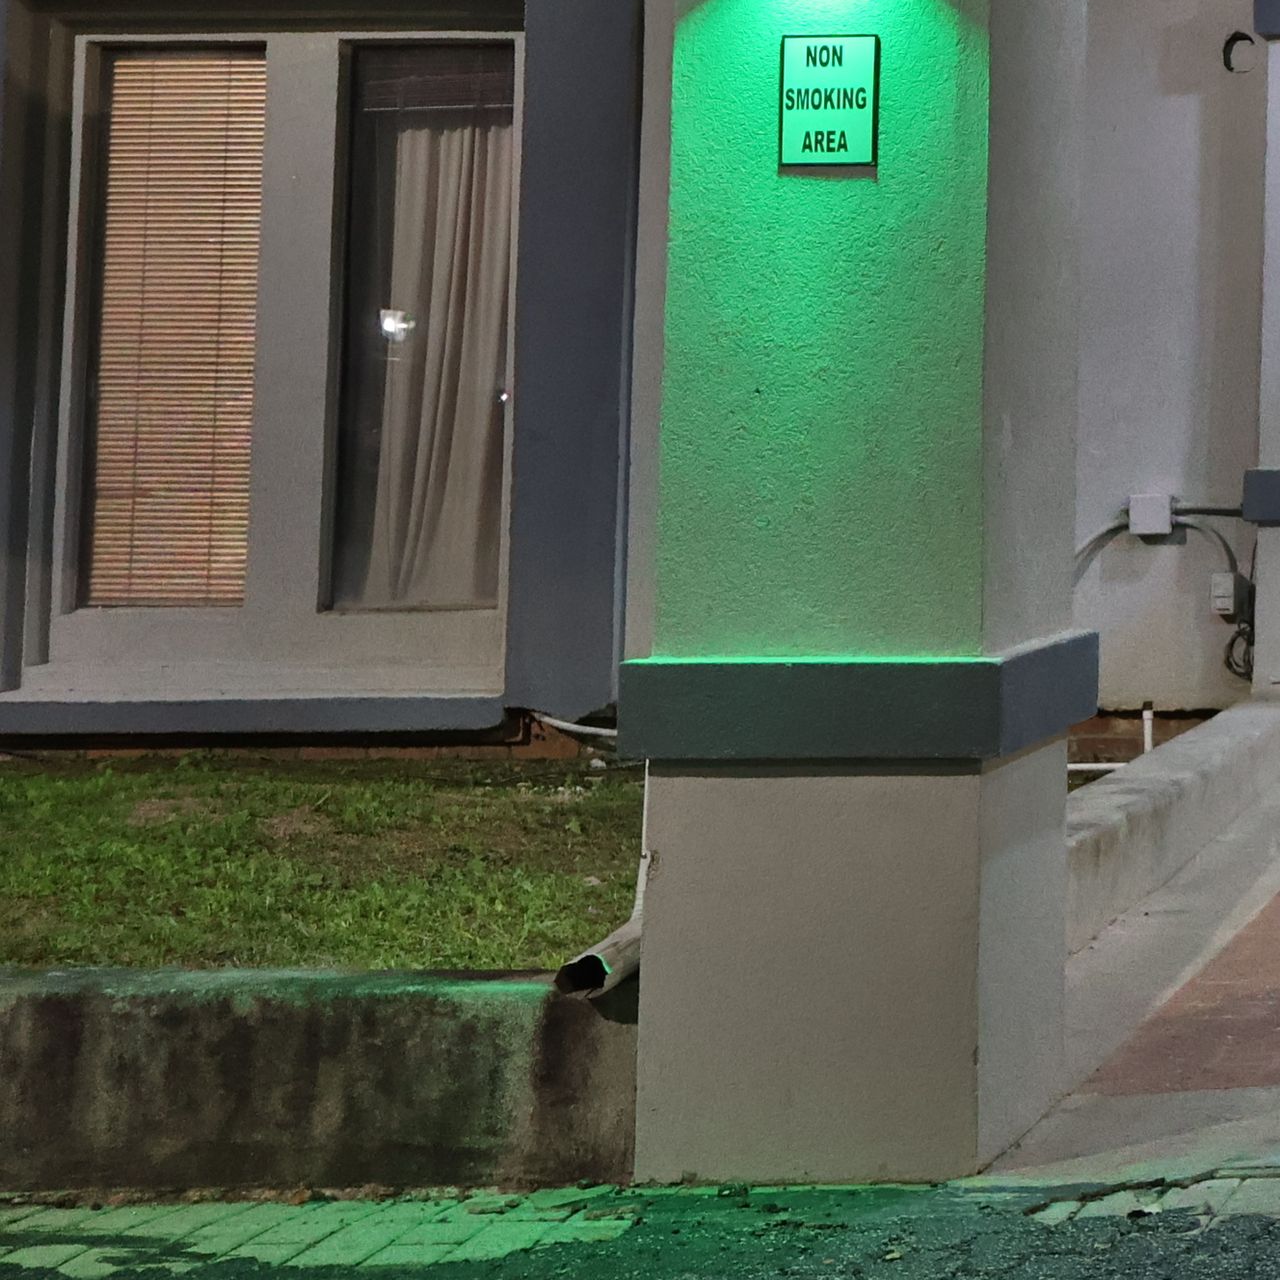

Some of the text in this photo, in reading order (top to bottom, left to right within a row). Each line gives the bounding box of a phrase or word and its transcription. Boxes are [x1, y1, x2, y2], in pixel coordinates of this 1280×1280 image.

[806, 45, 843, 68] NON
[785, 87, 867, 110] SMOKING
[801, 130, 848, 153] AREA
